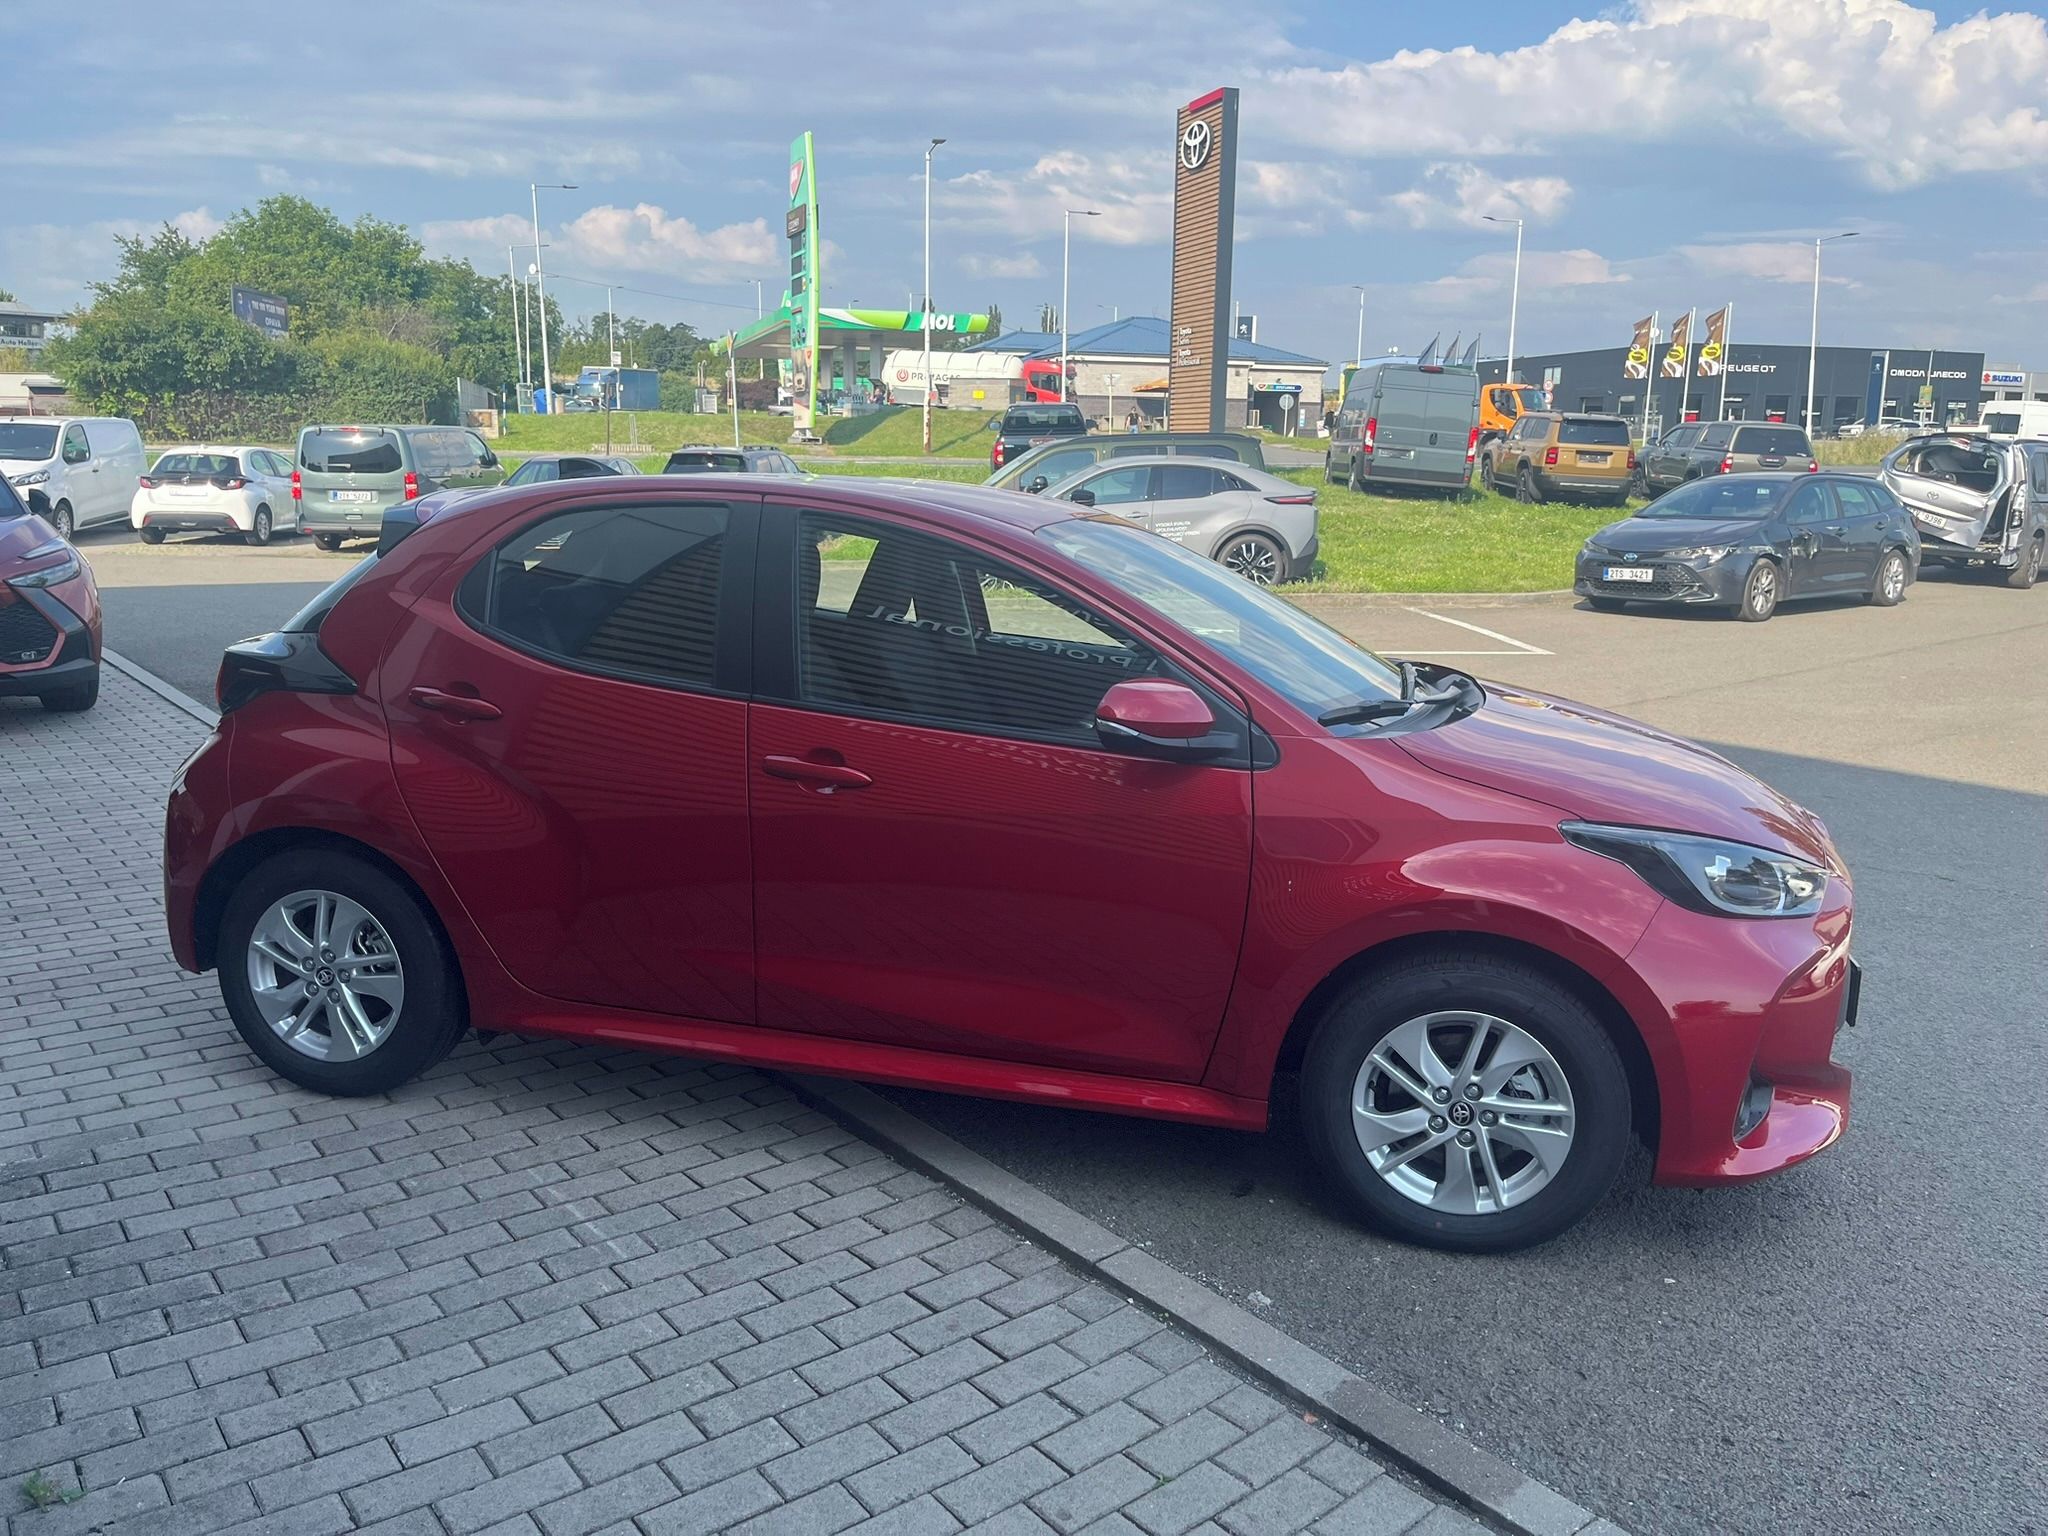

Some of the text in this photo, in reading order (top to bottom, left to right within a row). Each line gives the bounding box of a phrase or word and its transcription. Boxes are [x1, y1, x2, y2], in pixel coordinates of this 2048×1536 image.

[920, 314, 956, 331] MOL
[1890, 369, 1926, 378] OMODA
[1992, 374, 2023, 383] SUZUKI
[1610, 569, 1649, 579] 2TS 3421
